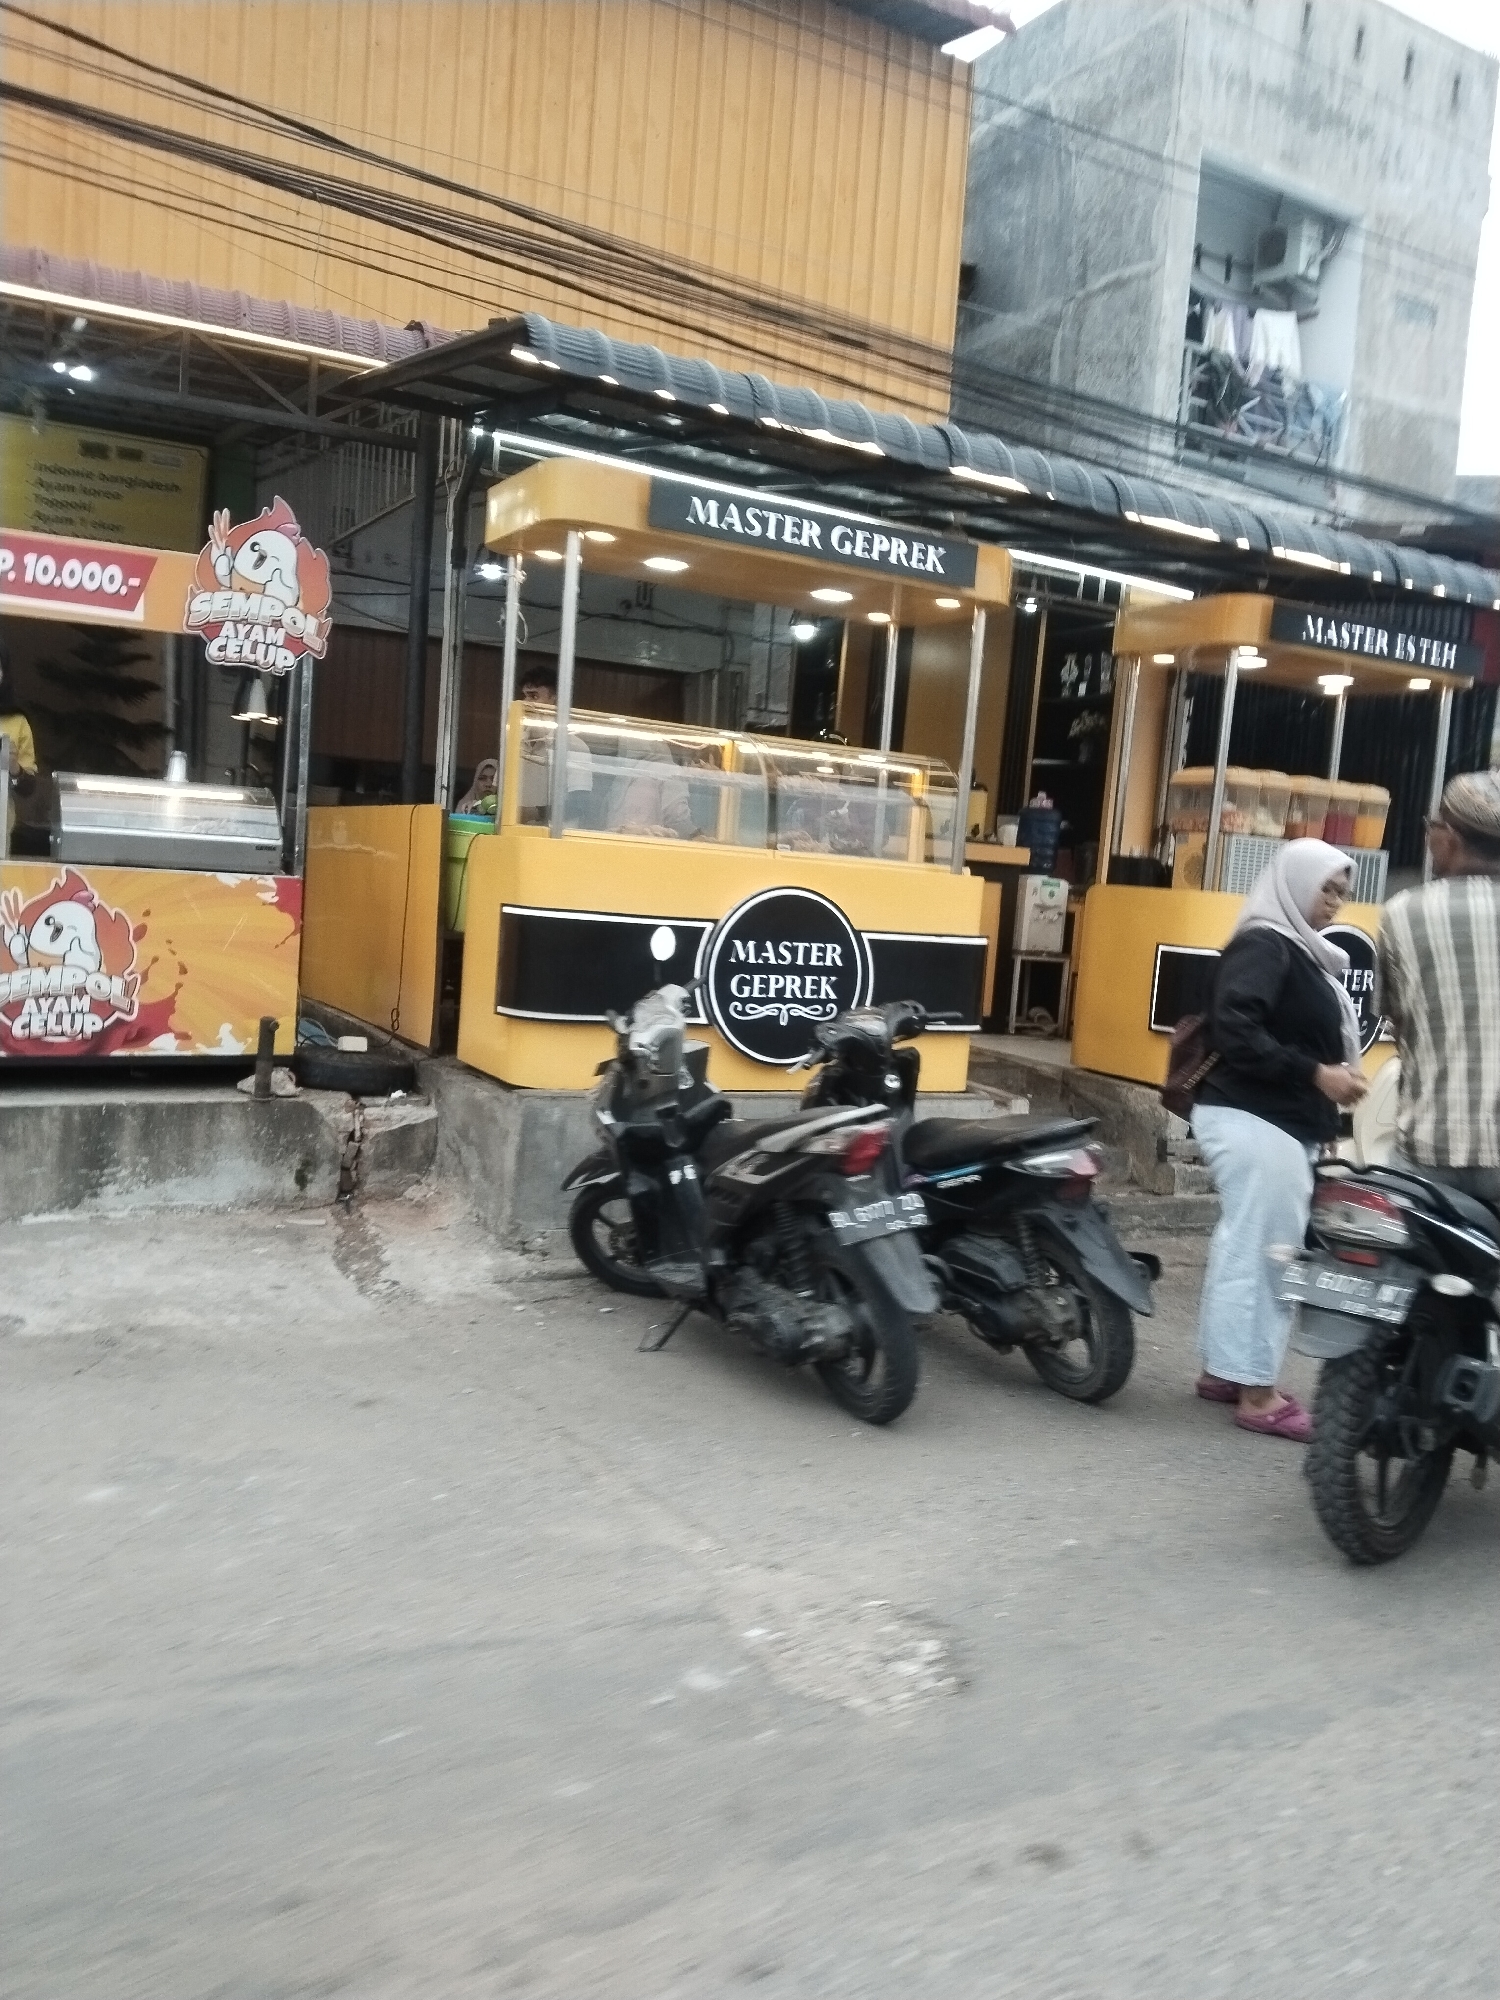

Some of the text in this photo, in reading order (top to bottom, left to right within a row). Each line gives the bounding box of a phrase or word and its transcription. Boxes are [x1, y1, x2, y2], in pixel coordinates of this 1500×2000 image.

[686, 496, 946, 574] MASTER GEPREK
[187, 591, 323, 652] SEMPOL
[219, 621, 287, 646] AYAM
[208, 636, 297, 675] CELUP
[1302, 614, 1457, 670] MASTER ESTEH
[728, 939, 844, 967] MASTER
[730, 973, 839, 1000] GEPREK
[22, 995, 91, 1015] AYAM
[12, 1012, 104, 1040] CELUP
